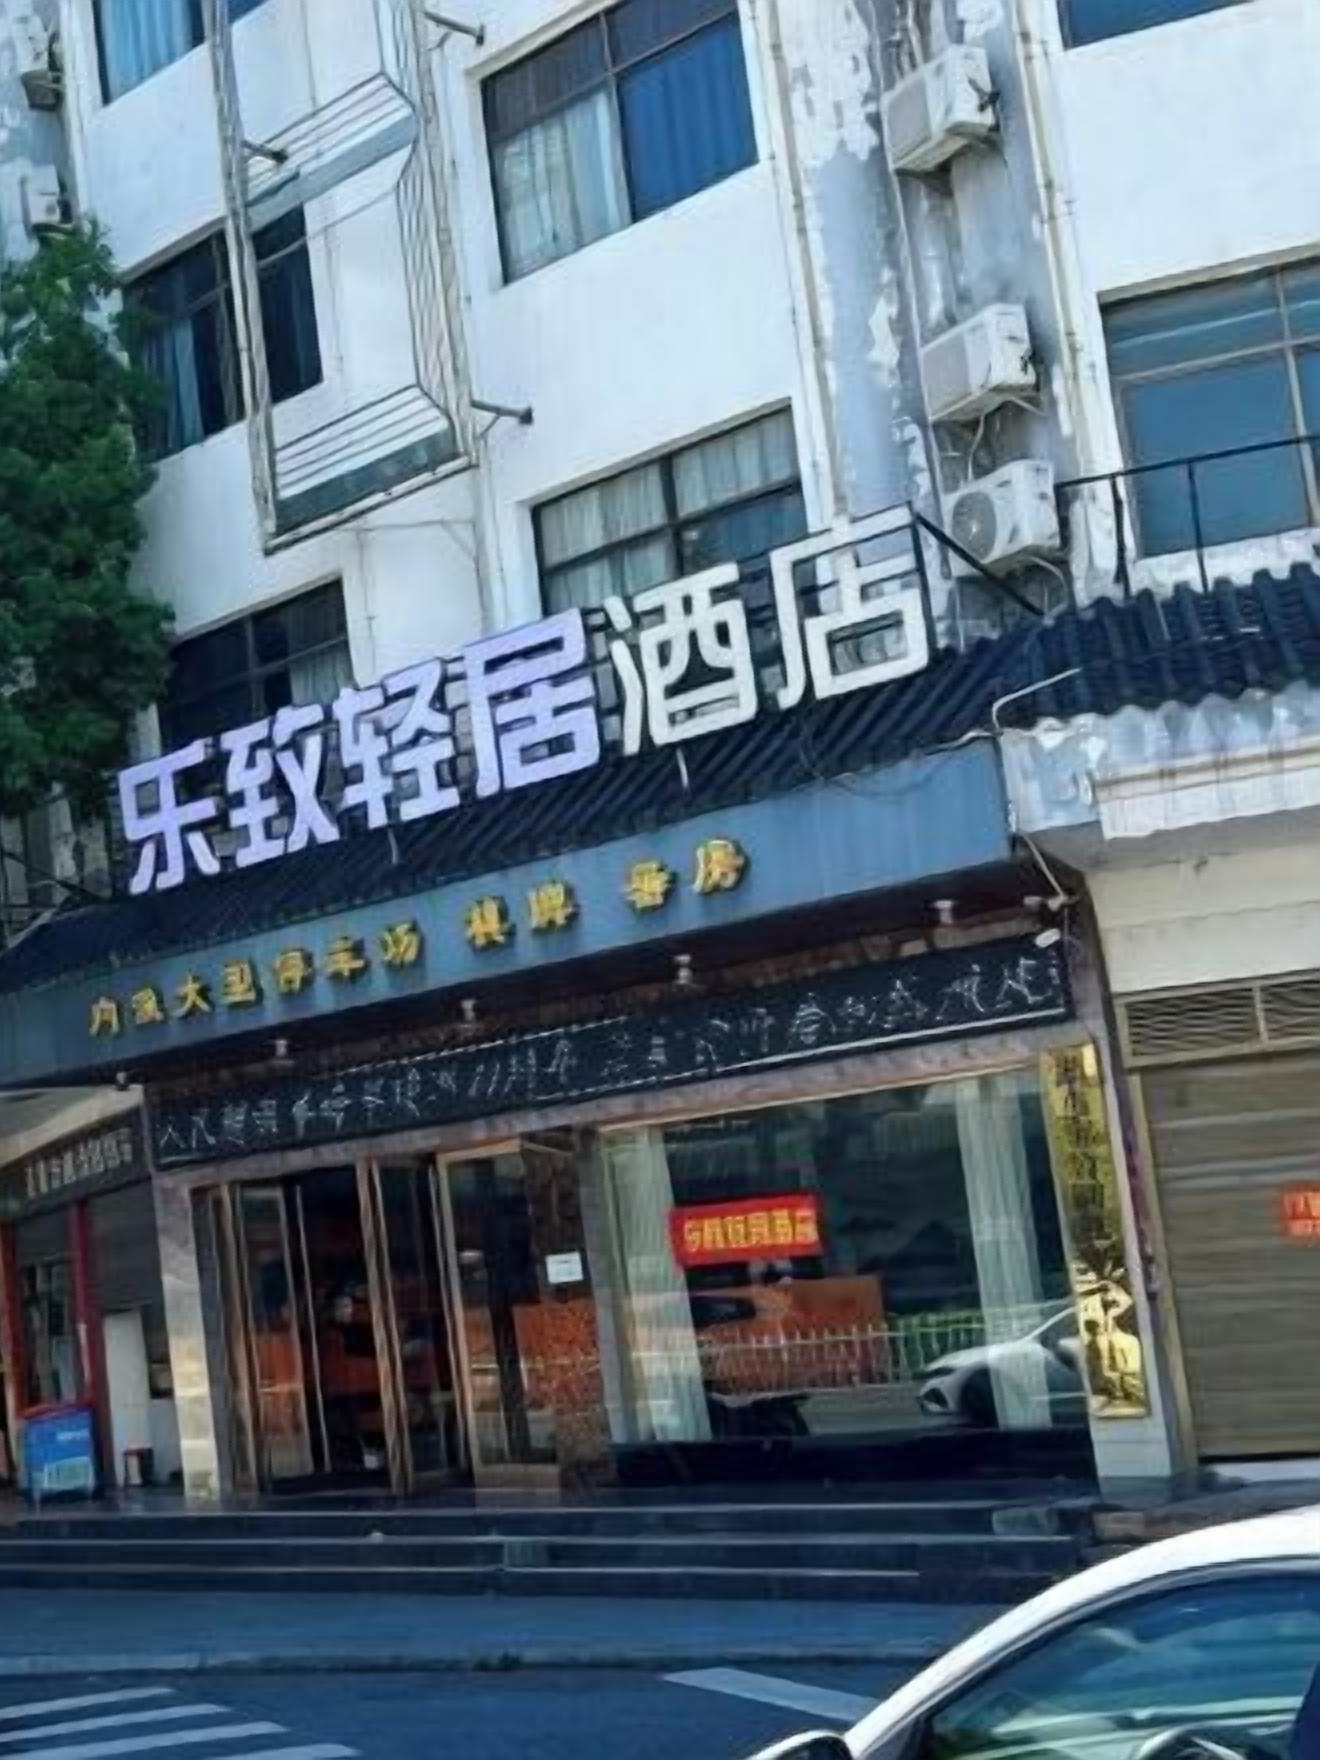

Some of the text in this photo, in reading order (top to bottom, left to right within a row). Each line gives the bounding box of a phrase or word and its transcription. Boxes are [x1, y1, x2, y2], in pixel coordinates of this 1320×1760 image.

[117, 507, 931, 895] 乐致轻居酒店
